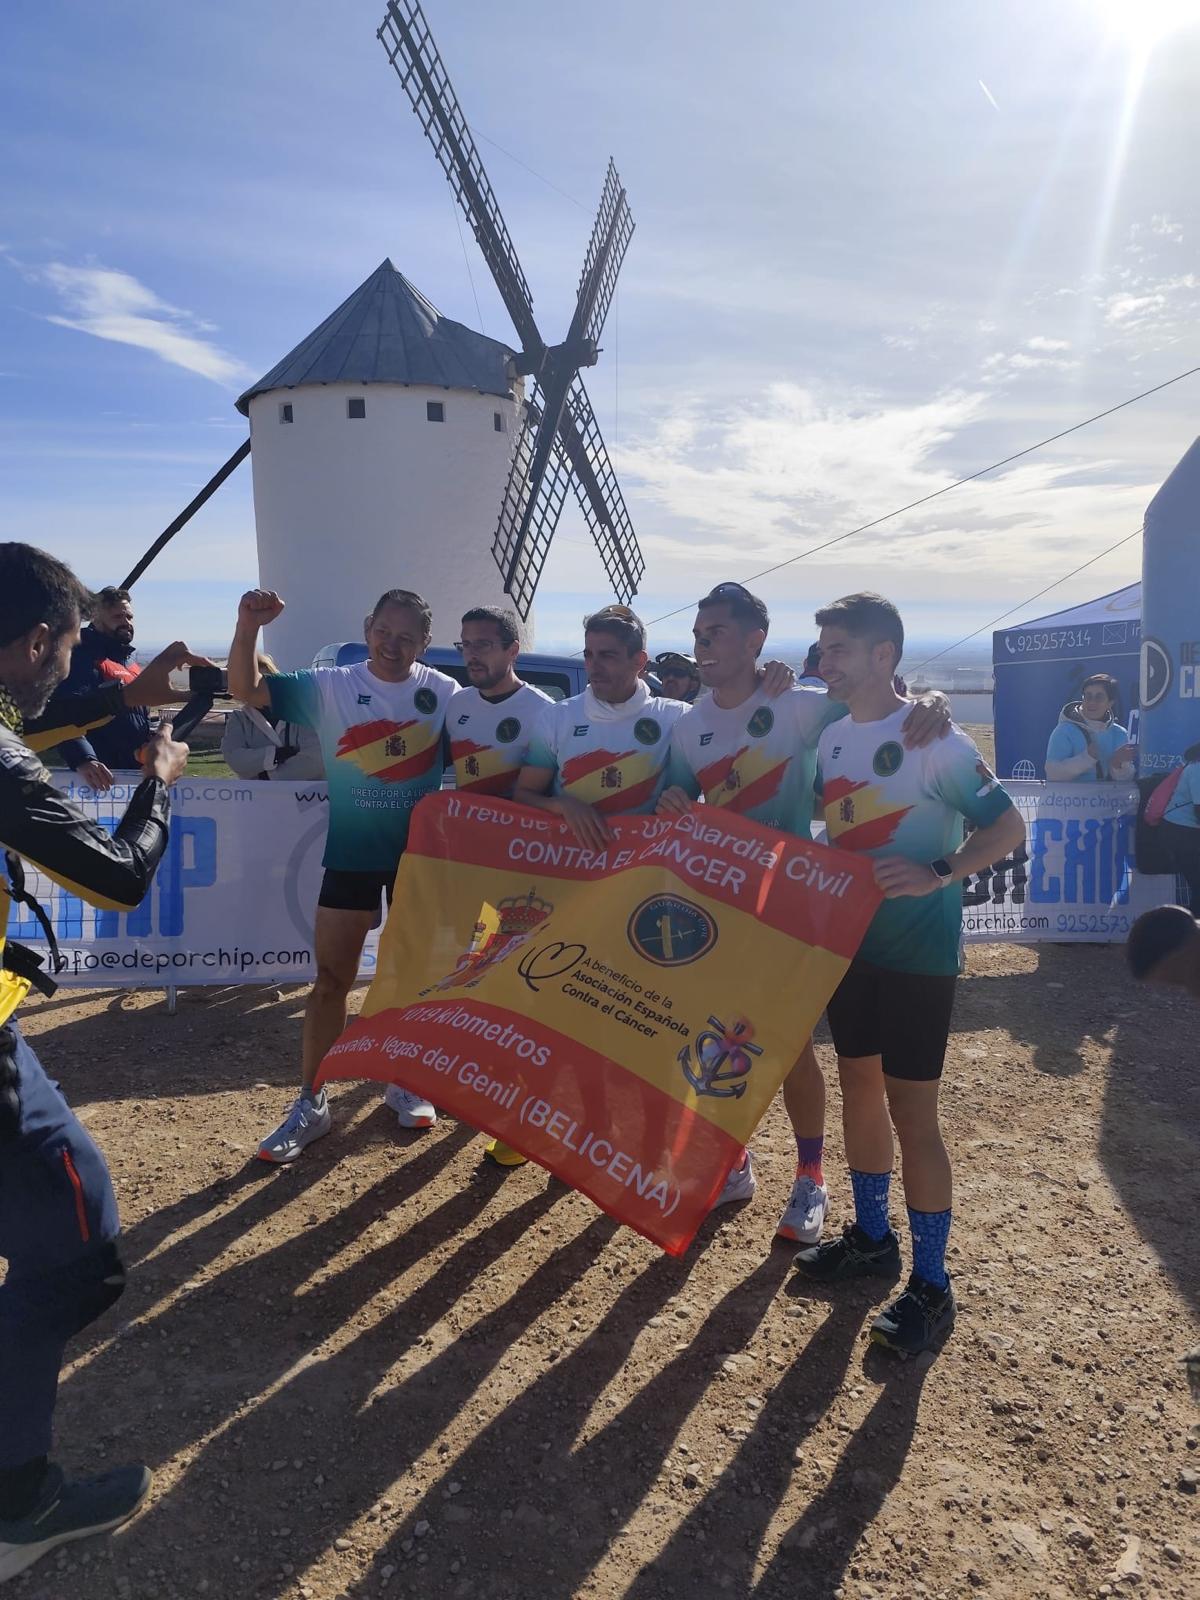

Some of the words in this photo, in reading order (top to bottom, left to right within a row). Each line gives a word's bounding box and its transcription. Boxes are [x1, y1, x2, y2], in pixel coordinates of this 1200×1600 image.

[1017, 630, 1091, 652] 925257314
[355, 799, 388, 808] CONTRA
[508, 838, 608, 870] CONTRA
[612, 849, 636, 870] EL
[675, 814, 779, 869] Guardia
[785, 856, 853, 898] Civil
[561, 983, 600, 1008] Contra
[601, 1004, 615, 1015] el
[614, 1010, 658, 1038] Cáncer
[571, 970, 632, 1007] Asociación
[634, 1001, 690, 1037] Española
[591, 960, 642, 993] beneficio
[644, 989, 660, 1003] de
[661, 996, 673, 1009] la
[381, 1035, 422, 1060] Vegas
[422, 1048, 460, 1075] del
[457, 1062, 521, 1109] Genil
[520, 1095, 681, 1218] (BELICENA)
